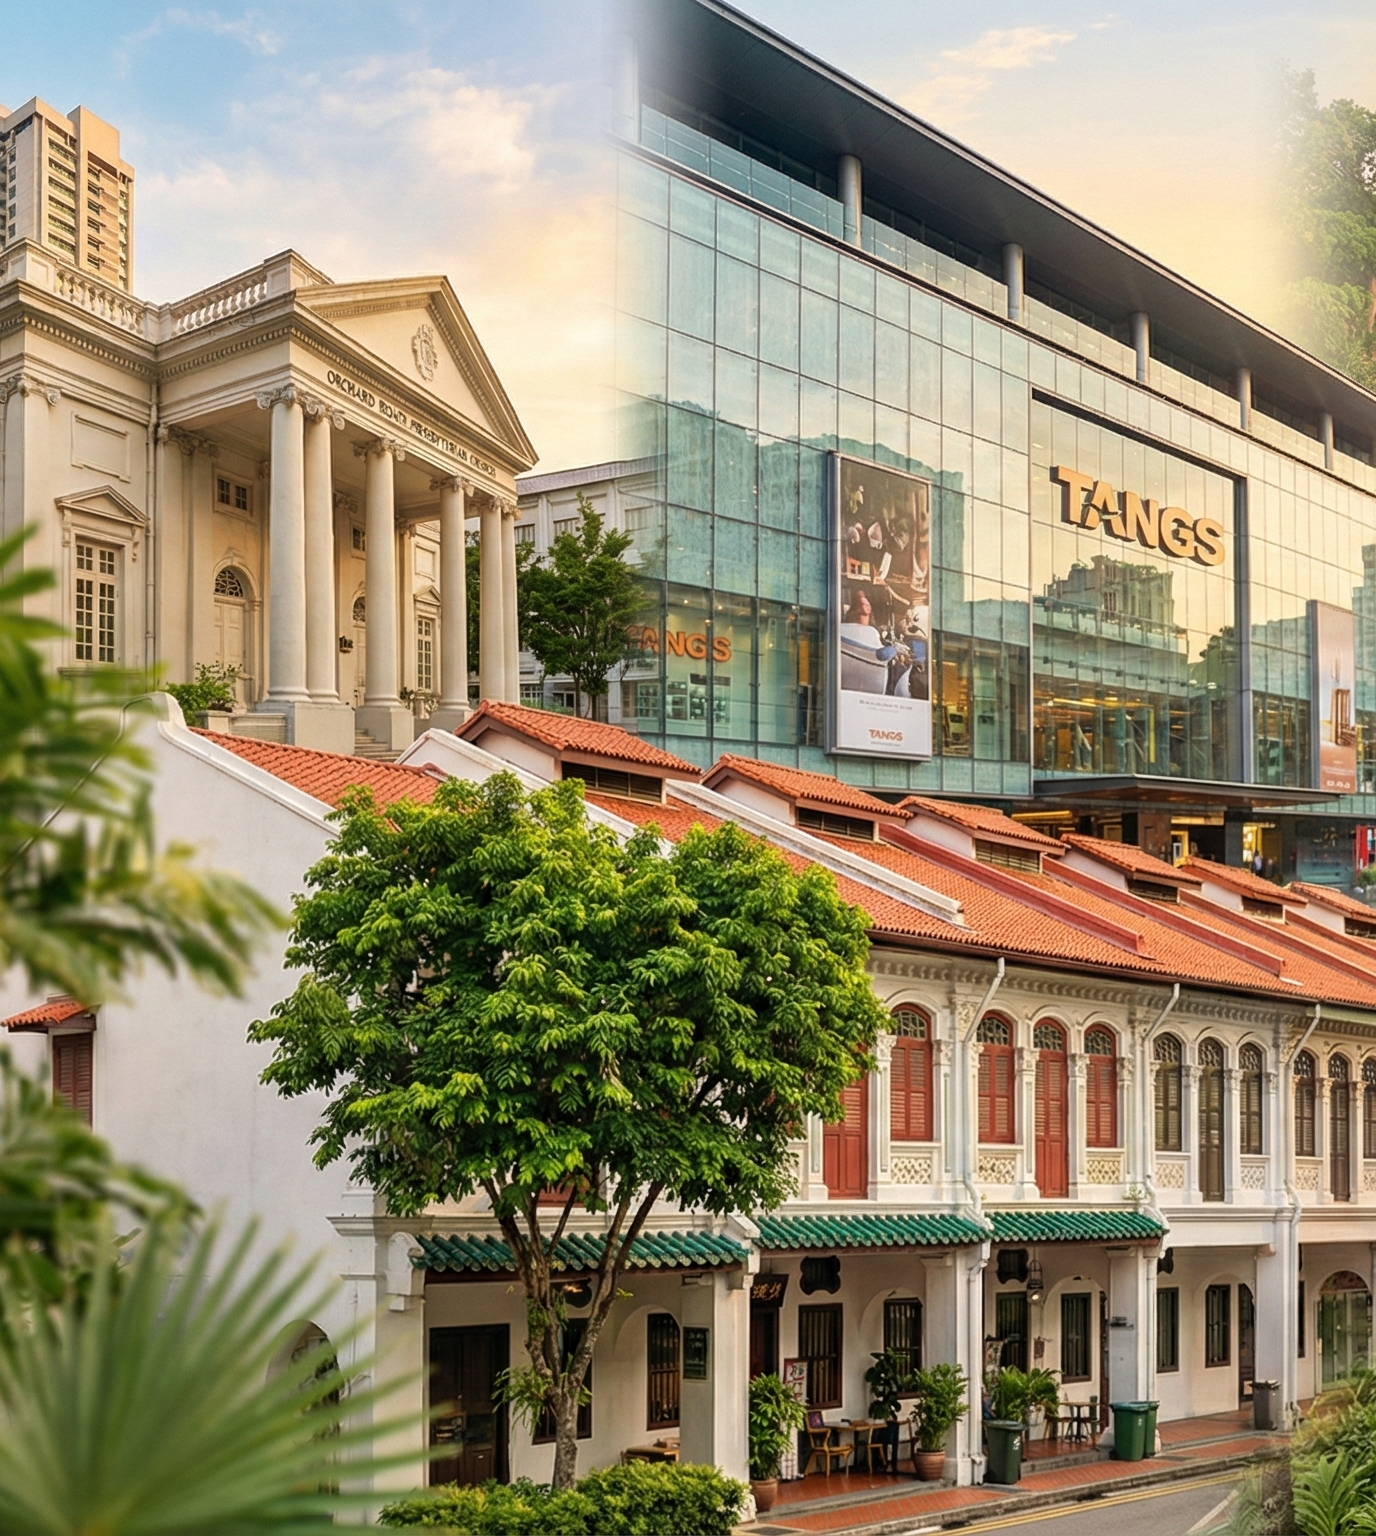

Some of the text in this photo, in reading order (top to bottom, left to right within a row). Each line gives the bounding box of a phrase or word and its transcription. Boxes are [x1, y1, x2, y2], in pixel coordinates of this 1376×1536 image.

[327, 369, 376, 408] ORCHARD
[1049, 465, 1226, 566] TANGS
[869, 728, 904, 742] TANGS
